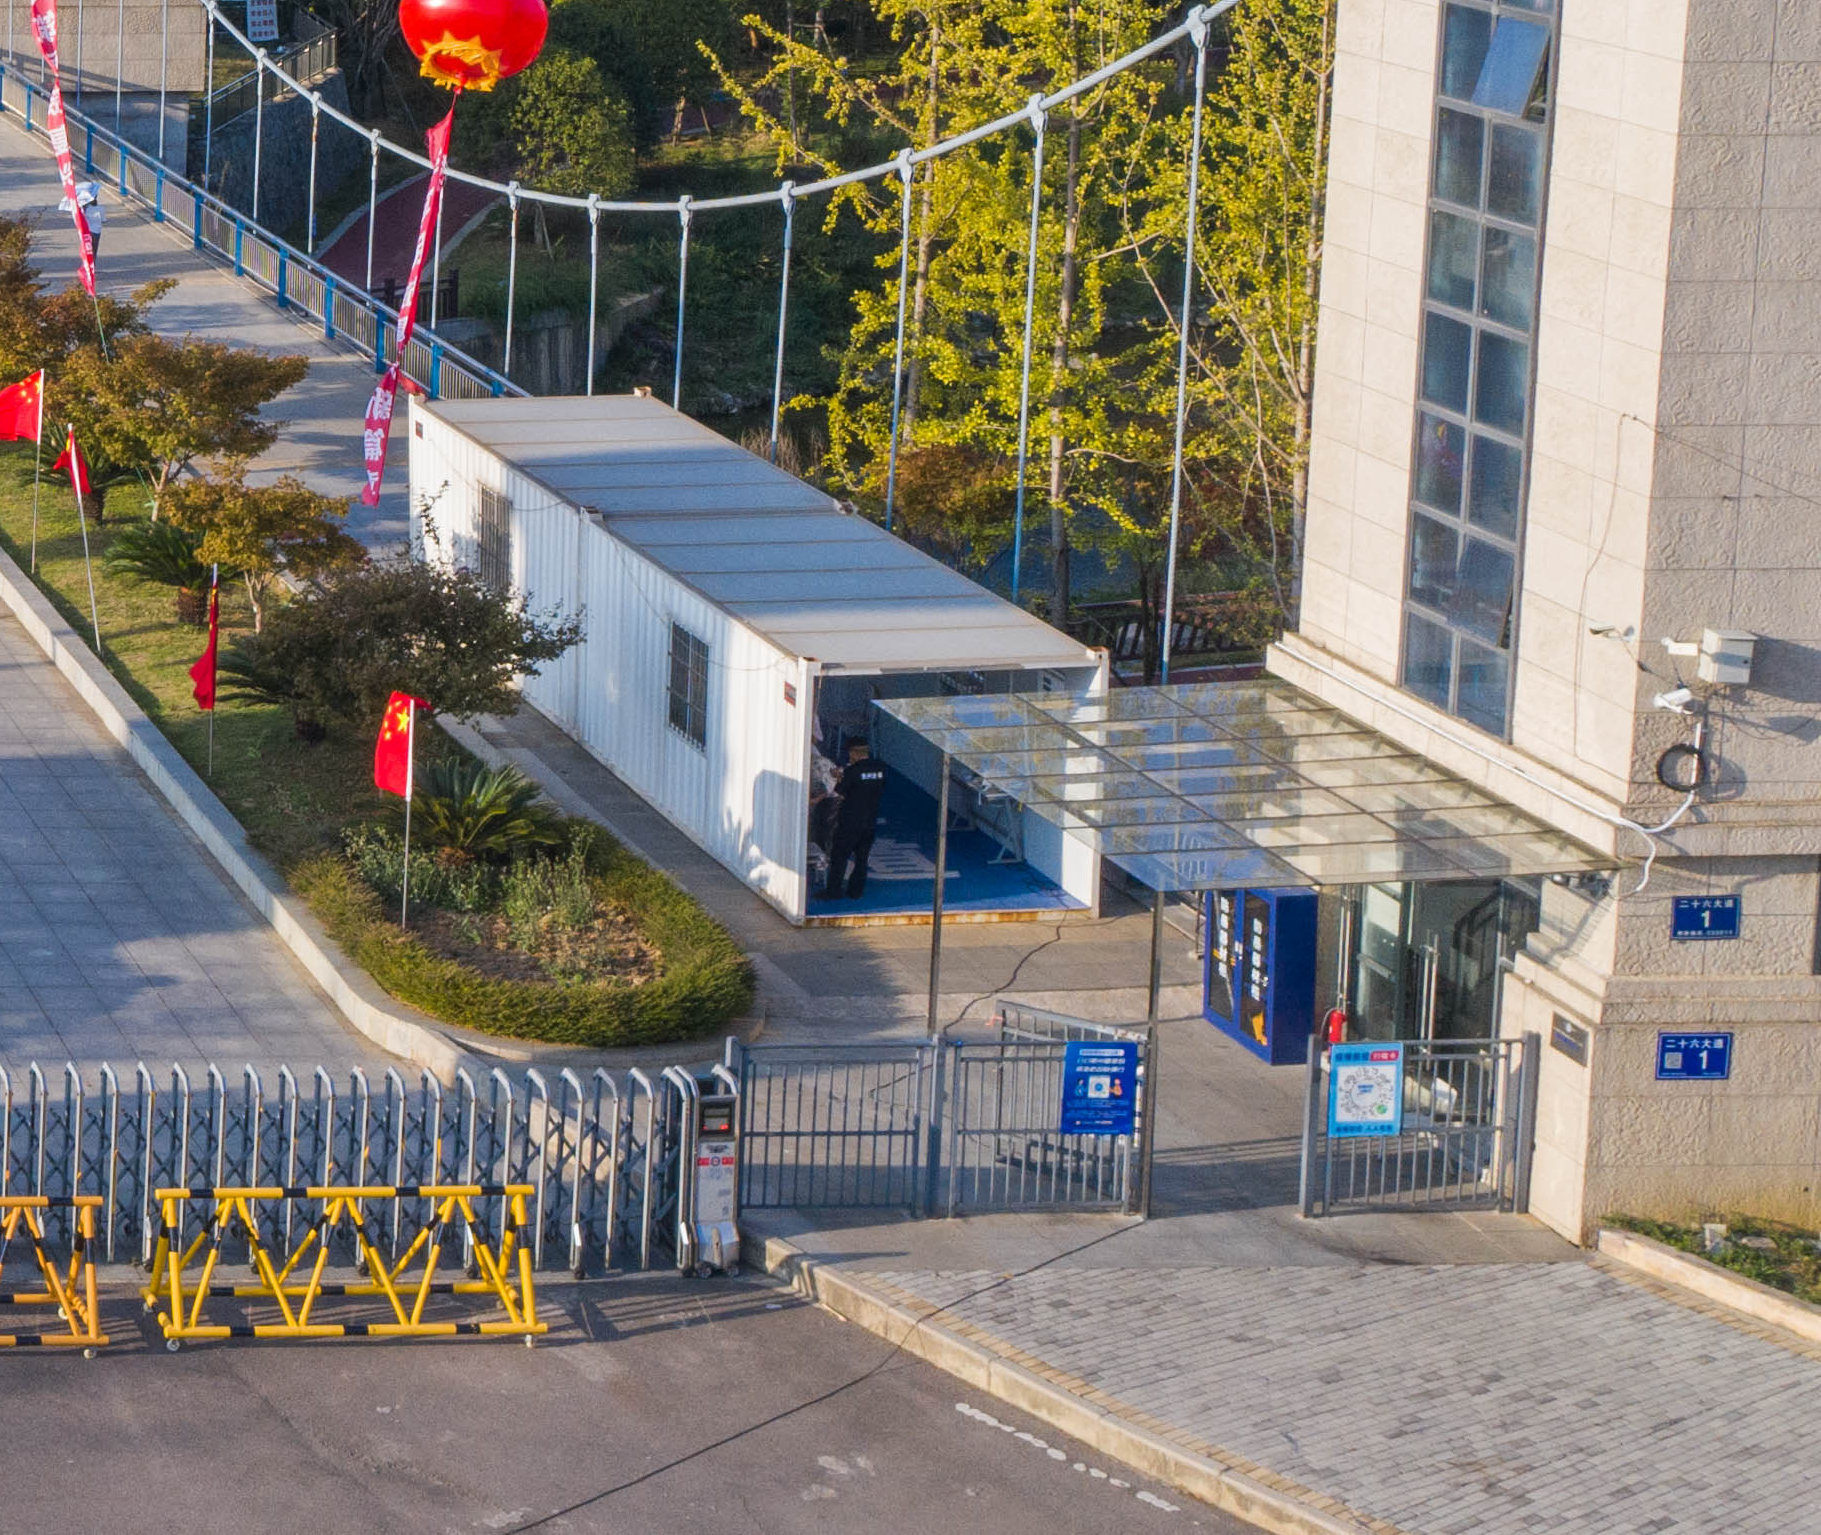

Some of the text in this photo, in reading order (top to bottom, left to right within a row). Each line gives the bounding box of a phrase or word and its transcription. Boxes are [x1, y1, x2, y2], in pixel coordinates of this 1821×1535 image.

[1678, 899, 1734, 909] 二十六大道
[1701, 910, 1711, 928] 1
[1665, 1038, 1724, 1049] 二十六大道
[1699, 1050, 1708, 1070] 1
